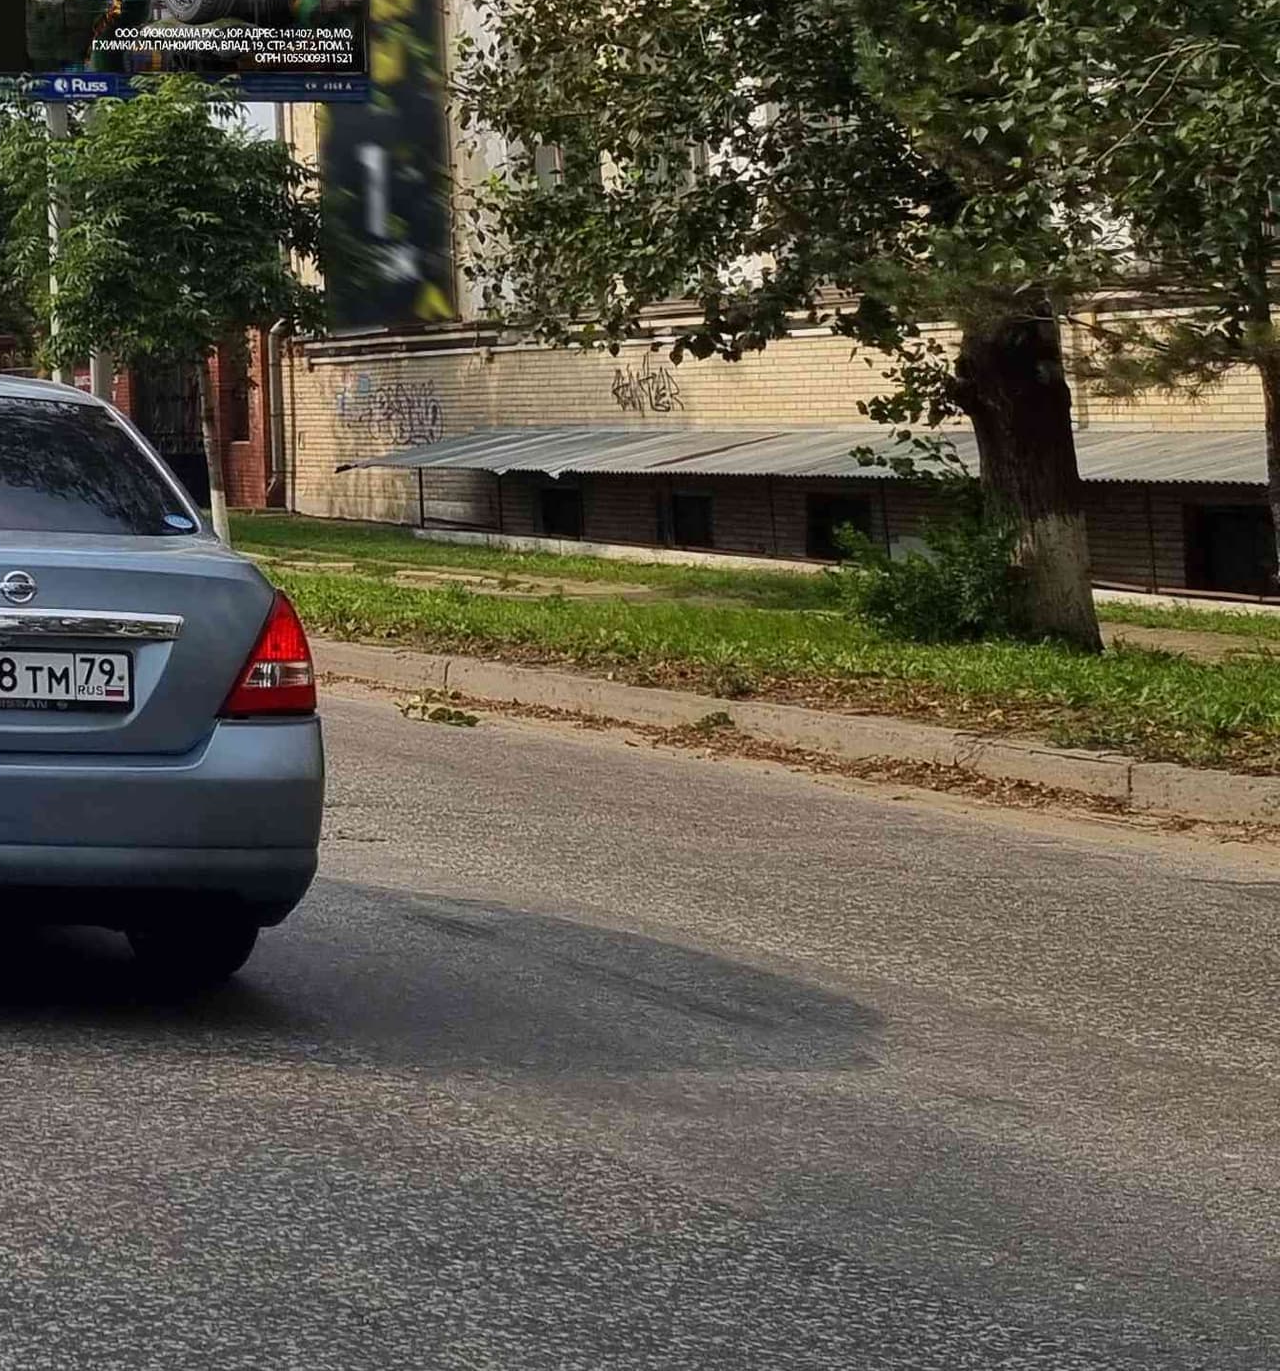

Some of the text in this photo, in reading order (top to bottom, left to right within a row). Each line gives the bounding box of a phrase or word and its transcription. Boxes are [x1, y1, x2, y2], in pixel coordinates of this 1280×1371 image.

[115, 28, 139, 39] ООО
[140, 26, 201, 39] «ЙОКОХАМА
[244, 28, 278, 40] АДРЕС:
[280, 29, 314, 40] 141407,
[252, 41, 265, 52] 19,
[255, 53, 353, 64] ОГРН 1055009311521
[72, 78, 108, 92] Russ
[79, 657, 115, 686] 79
[78, 685, 104, 696] RUS
